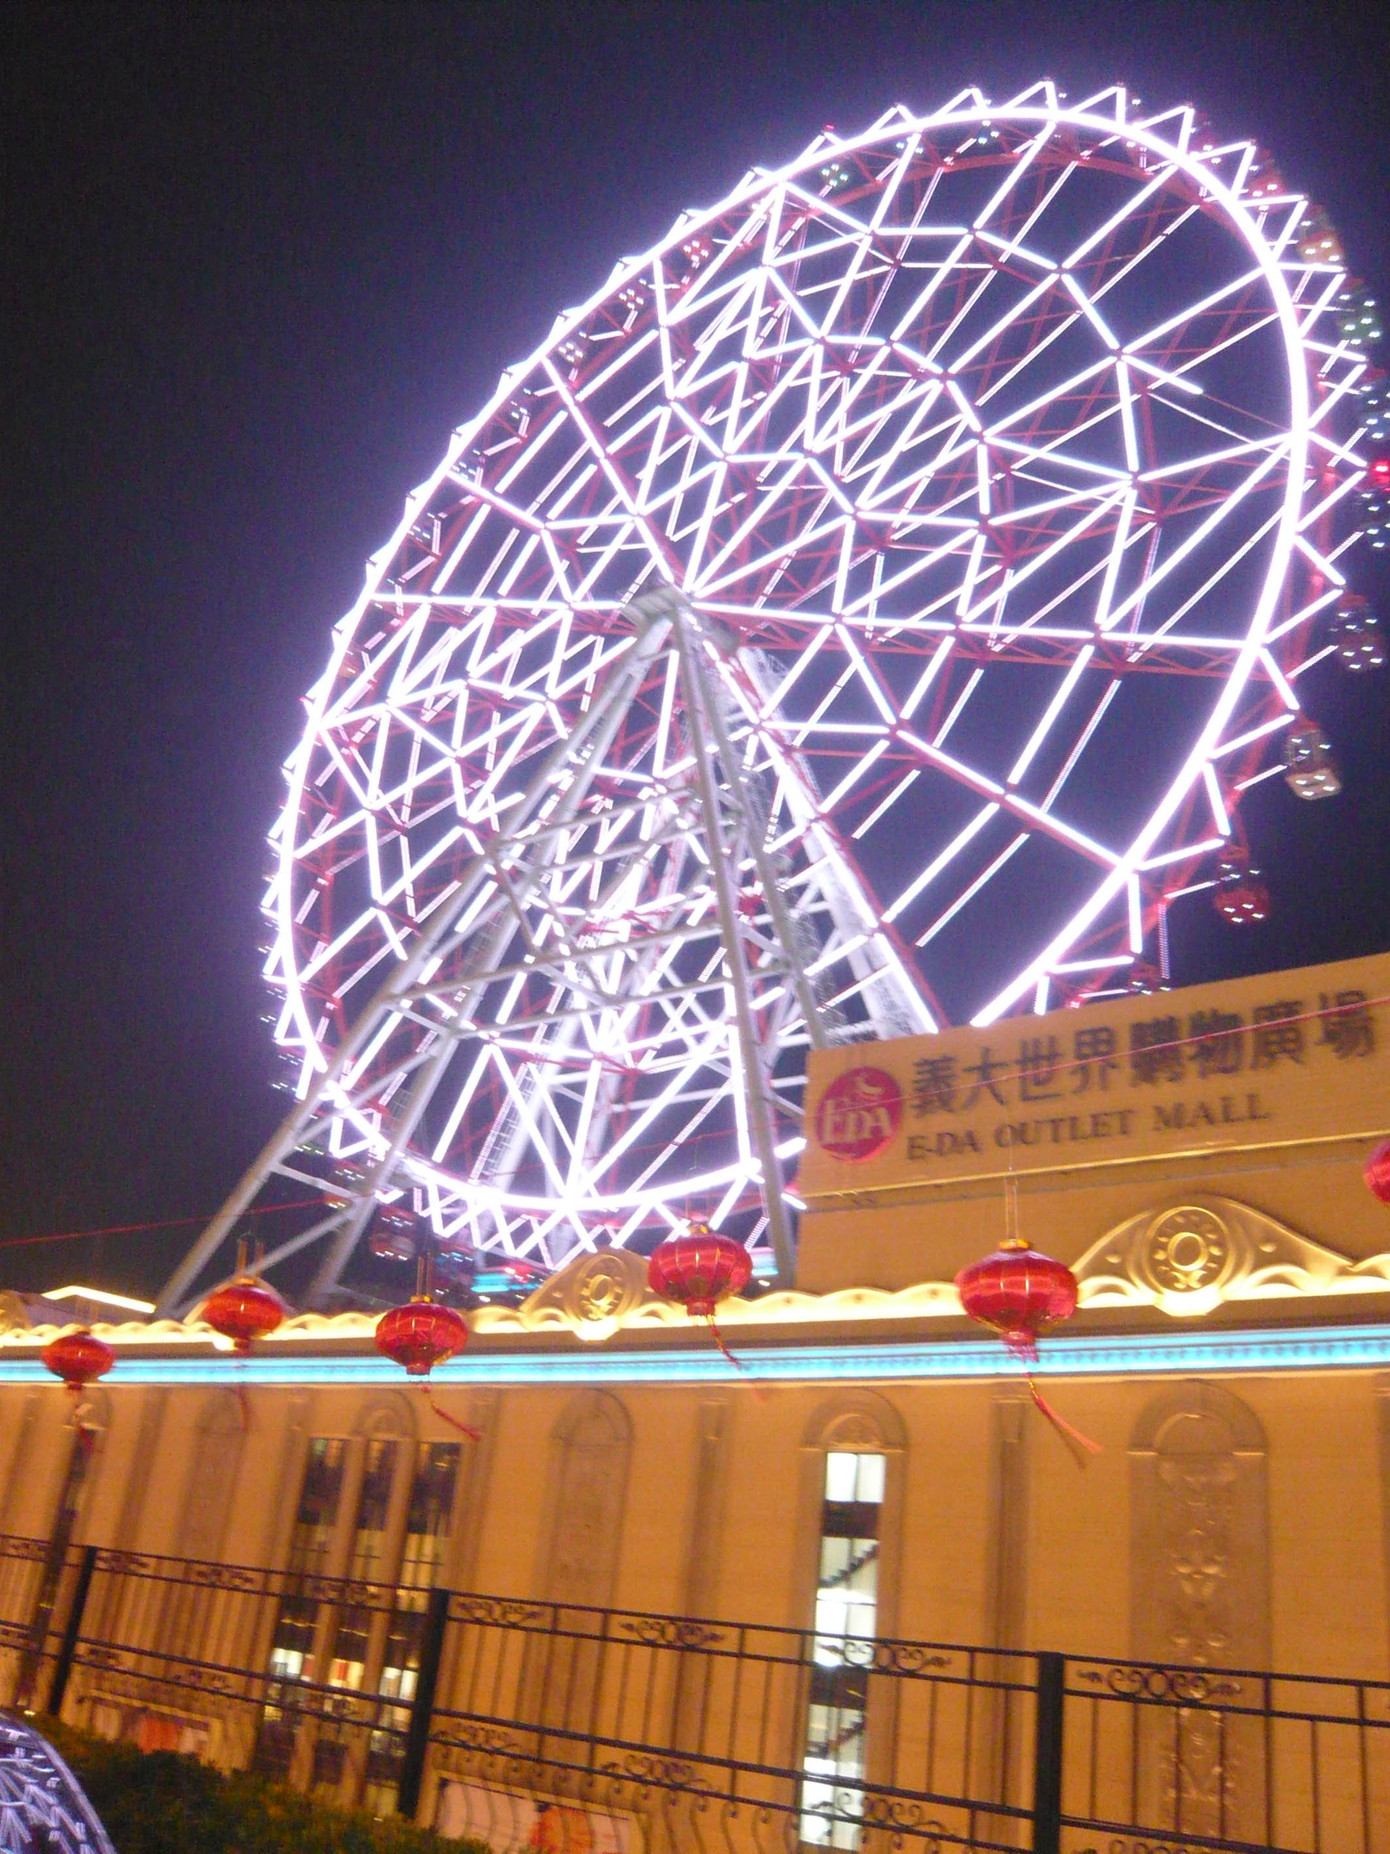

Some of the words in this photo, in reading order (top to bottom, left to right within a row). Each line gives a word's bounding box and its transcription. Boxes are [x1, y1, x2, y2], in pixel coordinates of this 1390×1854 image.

[910, 991, 1375, 1118] 義大世界購物廣場
[908, 1130, 980, 1160] E-DA
[994, 1110, 1136, 1147] OUTLET
[1154, 1094, 1270, 1130] MALL
